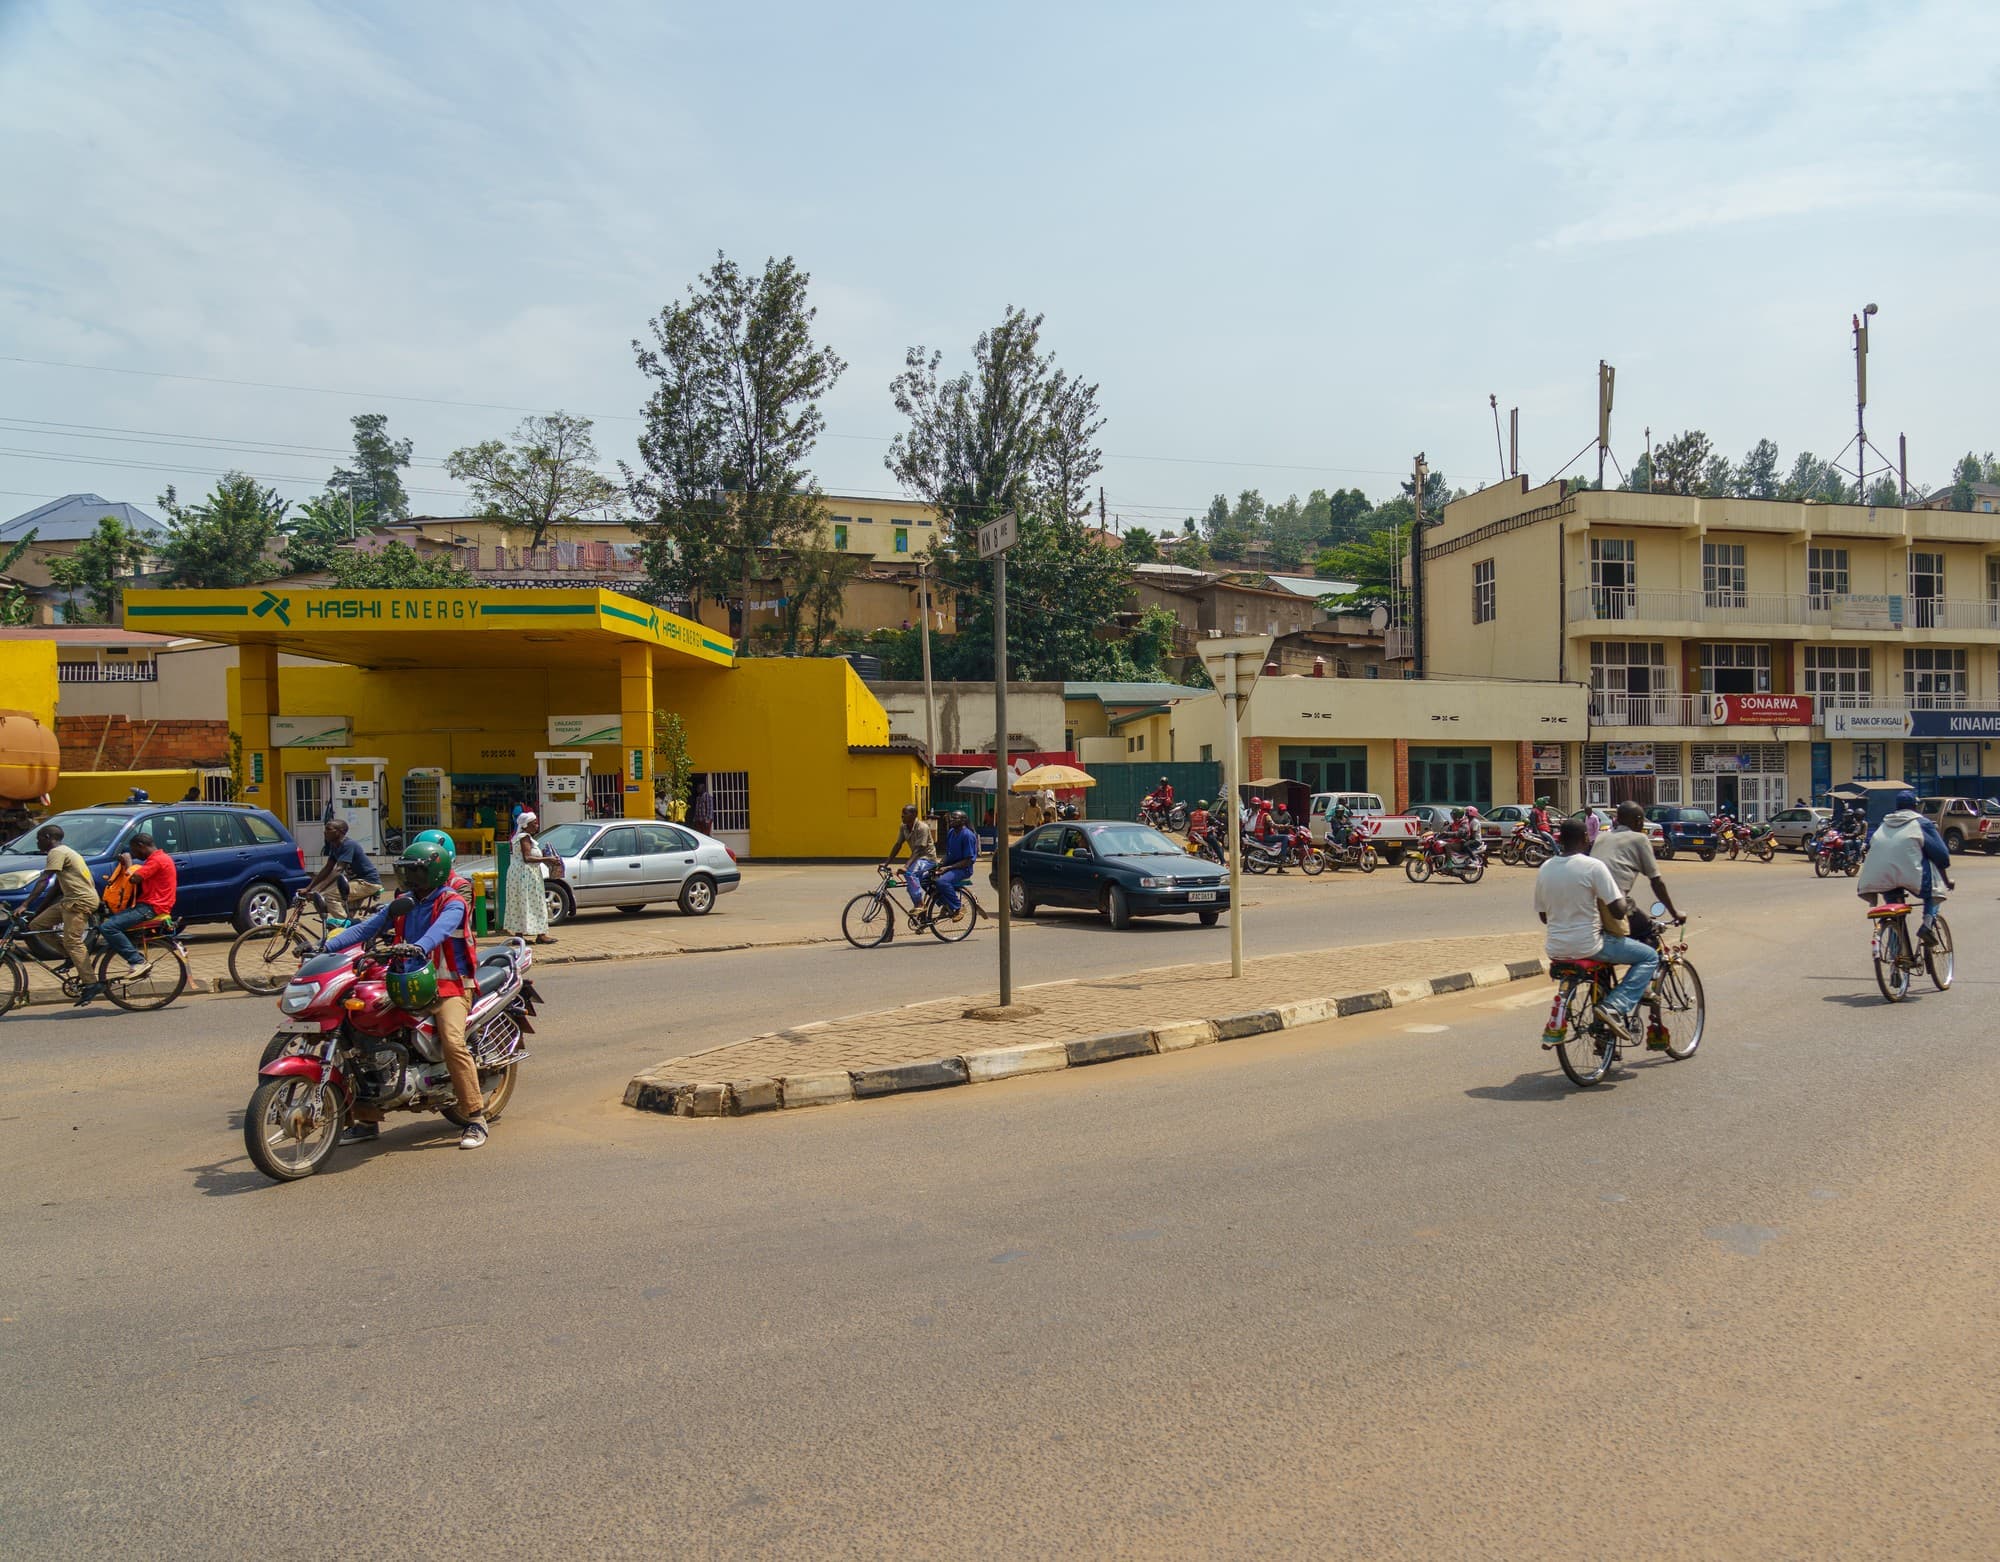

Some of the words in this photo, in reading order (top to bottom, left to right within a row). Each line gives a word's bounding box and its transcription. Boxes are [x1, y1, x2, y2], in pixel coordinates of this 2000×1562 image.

[982, 530, 991, 553] KN
[994, 527, 999, 548] 8
[306, 600, 381, 618] HASHI
[391, 600, 479, 619] ENERGY
[662, 620, 682, 641] HASHI
[682, 627, 702, 648] ENERGY
[1740, 697, 1799, 709] SONARWA
[1835, 714, 1846, 731] bk
[1851, 717, 1870, 725] BANK
[1870, 717, 1880, 725] OF
[1880, 717, 1902, 726] KIGALI
